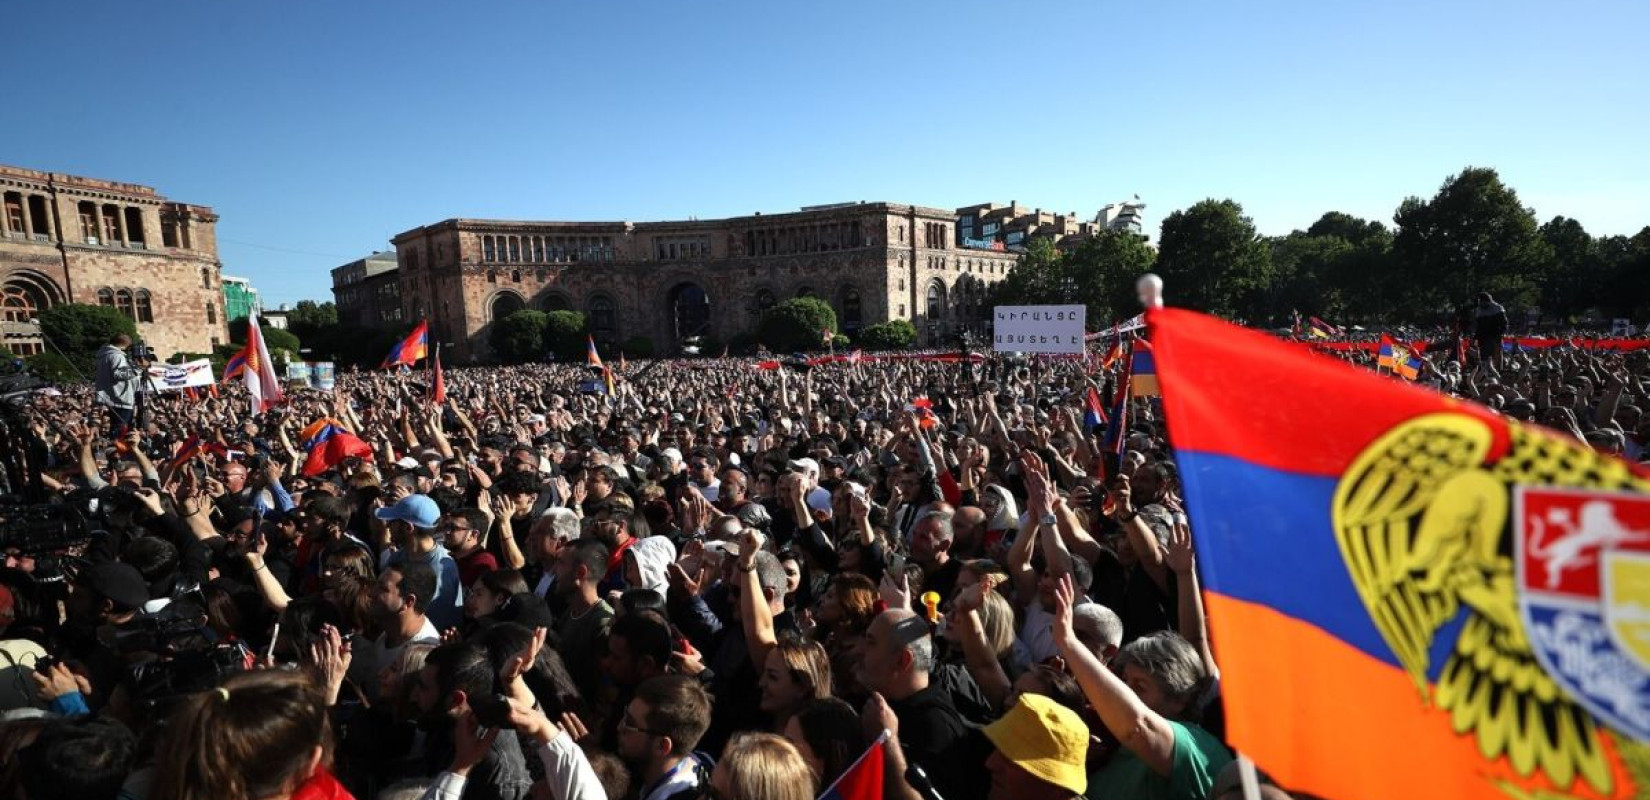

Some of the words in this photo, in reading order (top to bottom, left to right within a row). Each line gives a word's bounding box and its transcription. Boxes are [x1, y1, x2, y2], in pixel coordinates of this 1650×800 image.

[998, 311, 1076, 320] ԿԻՐԱՆՑԸ
[995, 334, 1060, 344] ԱՅՍՏԵՂ
[1071, 335, 1079, 344] Է
